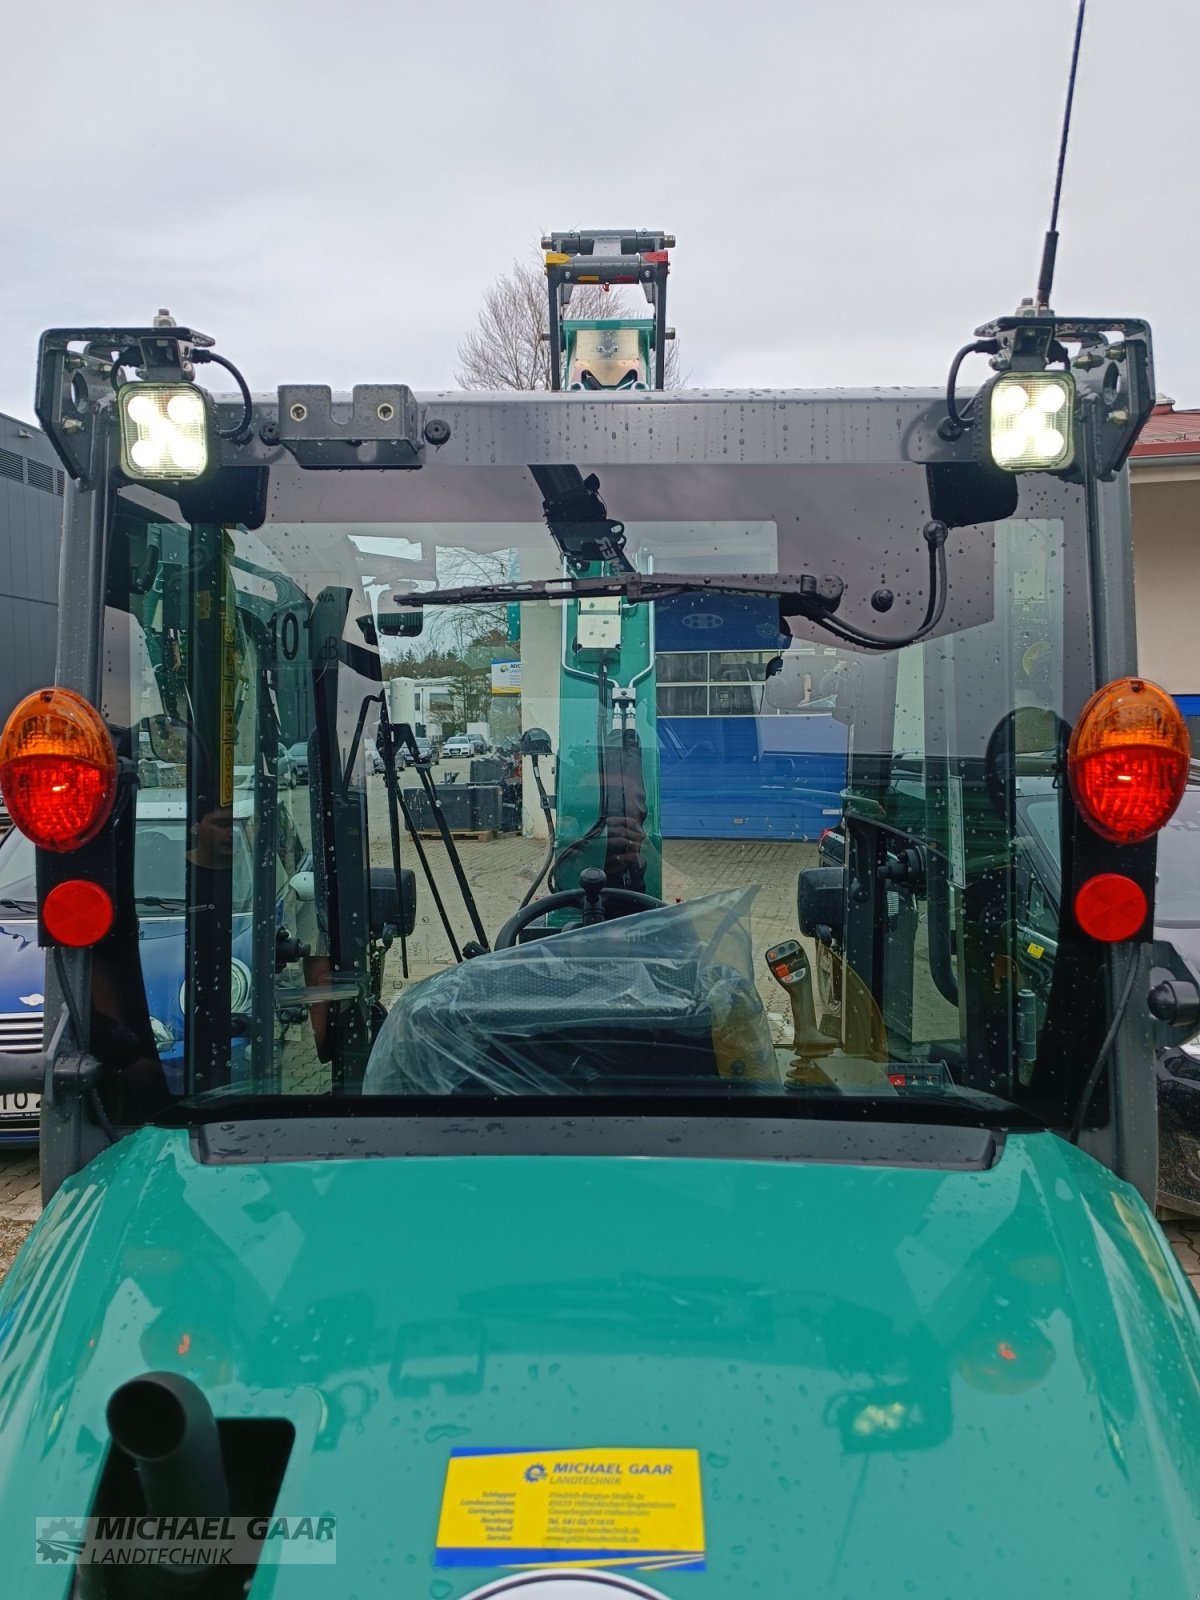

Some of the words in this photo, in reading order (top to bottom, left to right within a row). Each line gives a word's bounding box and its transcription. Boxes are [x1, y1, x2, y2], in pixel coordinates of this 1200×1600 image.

[553, 1463, 623, 1474] MICHAEL
[628, 1464, 673, 1475] GAAR
[549, 1475, 622, 1485] LANDTECHNIK
